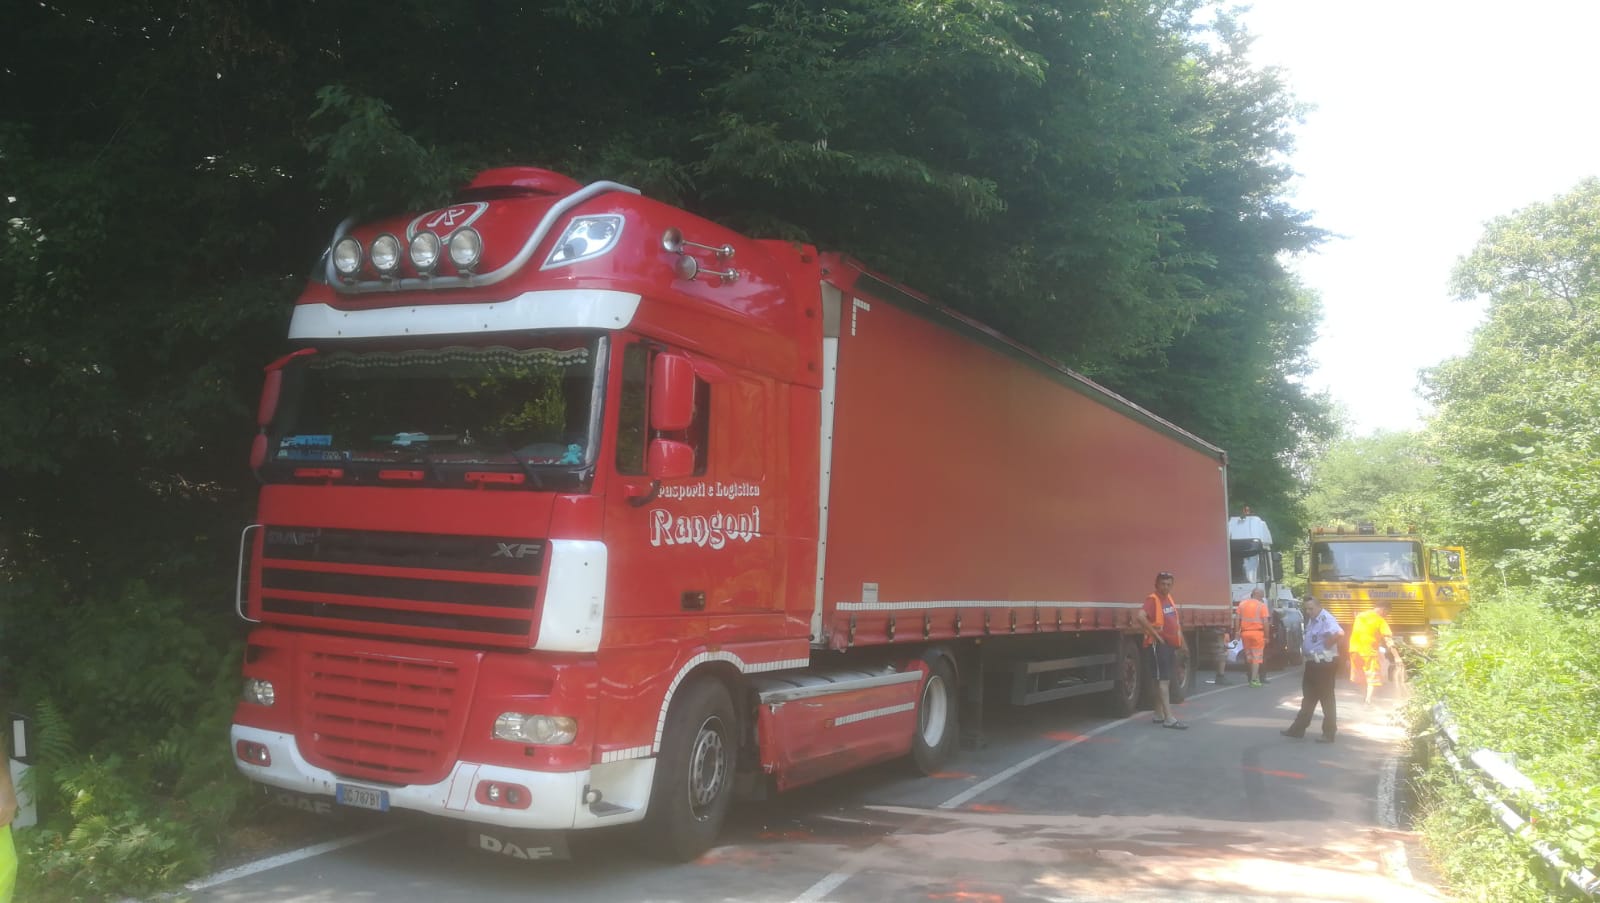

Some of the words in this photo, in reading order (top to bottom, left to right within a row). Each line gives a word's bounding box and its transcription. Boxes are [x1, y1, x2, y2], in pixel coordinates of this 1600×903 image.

[649, 482, 706, 500] rasporti
[707, 486, 714, 497] e
[715, 481, 760, 500] Logistica
[649, 505, 761, 550] Rangoni
[491, 542, 541, 558] XF
[479, 833, 553, 860] DAF
